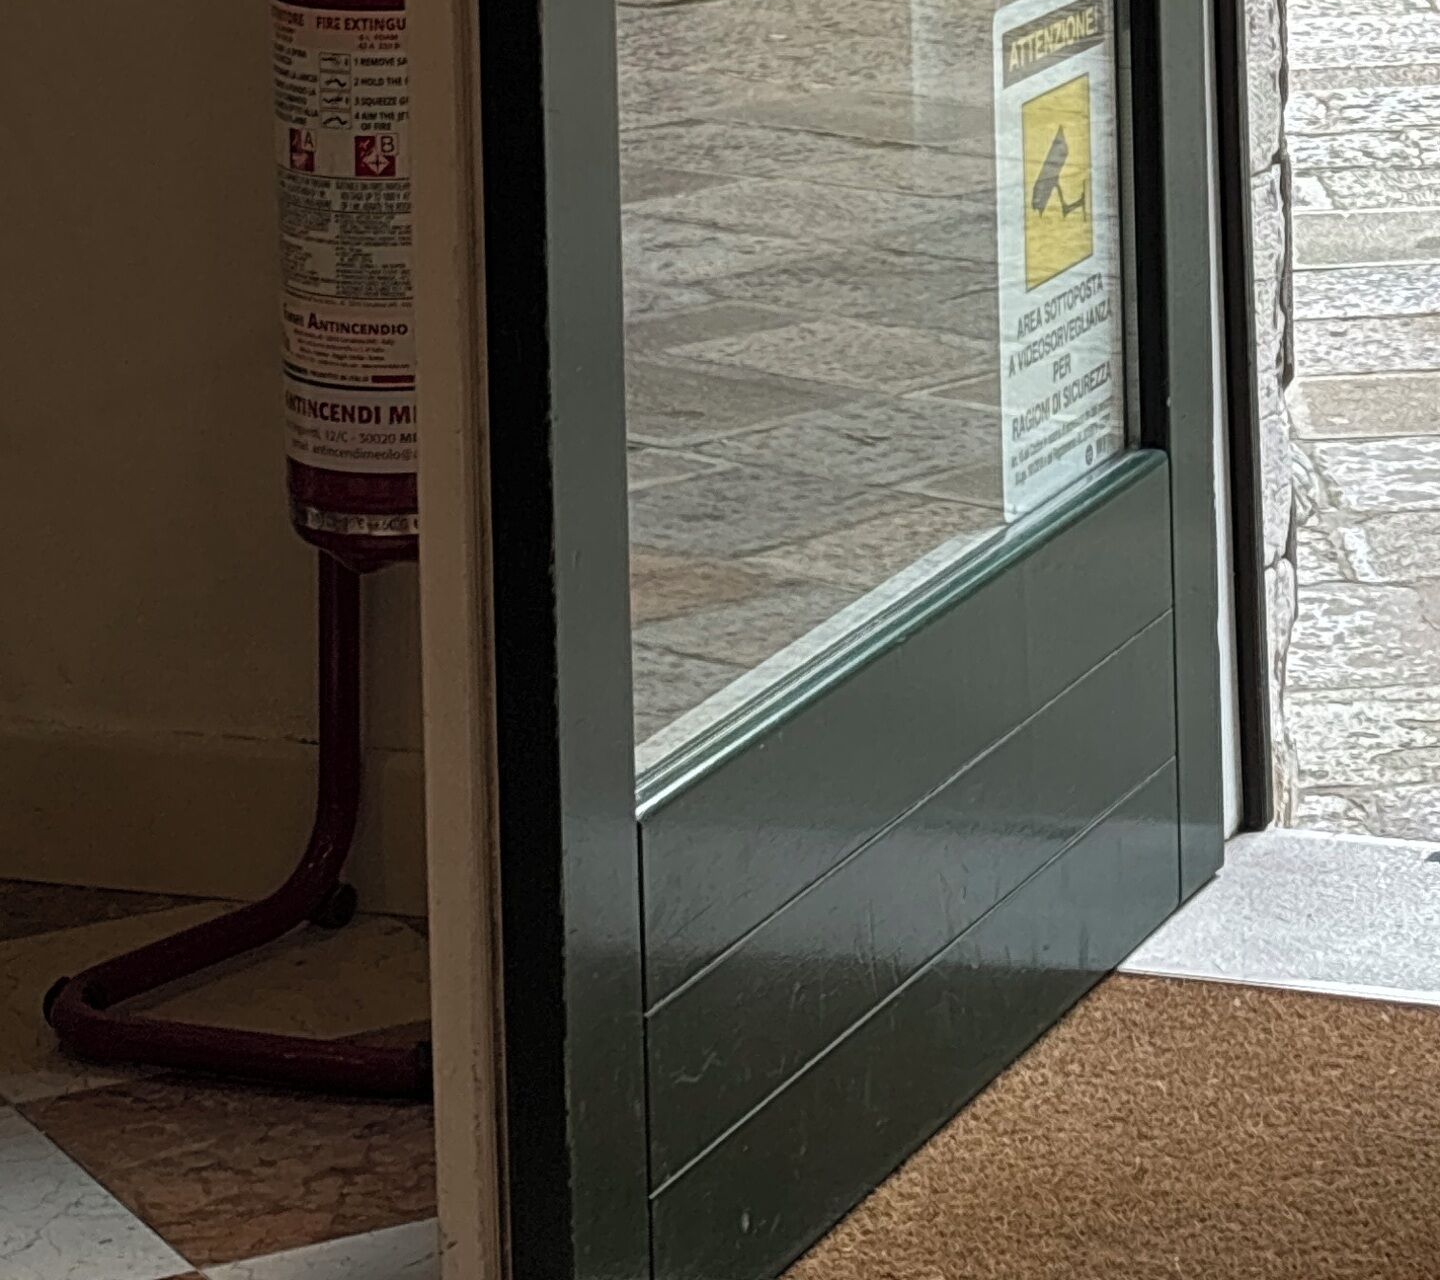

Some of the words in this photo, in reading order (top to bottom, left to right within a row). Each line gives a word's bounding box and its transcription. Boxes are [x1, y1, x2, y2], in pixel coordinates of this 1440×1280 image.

[316, 16, 341, 30] FIRE
[345, 17, 407, 31] EXTINGU
[1008, 5, 1098, 72] ATTENZIONE!
[361, 77, 385, 86] HOLD
[304, 131, 313, 148] A
[380, 136, 395, 153] B
[1017, 307, 1042, 340] AREA
[1044, 272, 1103, 324] SOTTOPOSTA
[308, 312, 409, 335] ANTINCENDIO
[1008, 354, 1016, 378] A
[1017, 296, 1112, 371] VIDEOSORVEGLIANZA
[1052, 352, 1071, 382] PER
[1012, 396, 1050, 442] RAGIONI
[1052, 389, 1061, 415] DI
[1063, 361, 1112, 408] SICUREZZA
[326, 430, 348, 443] 12/C
